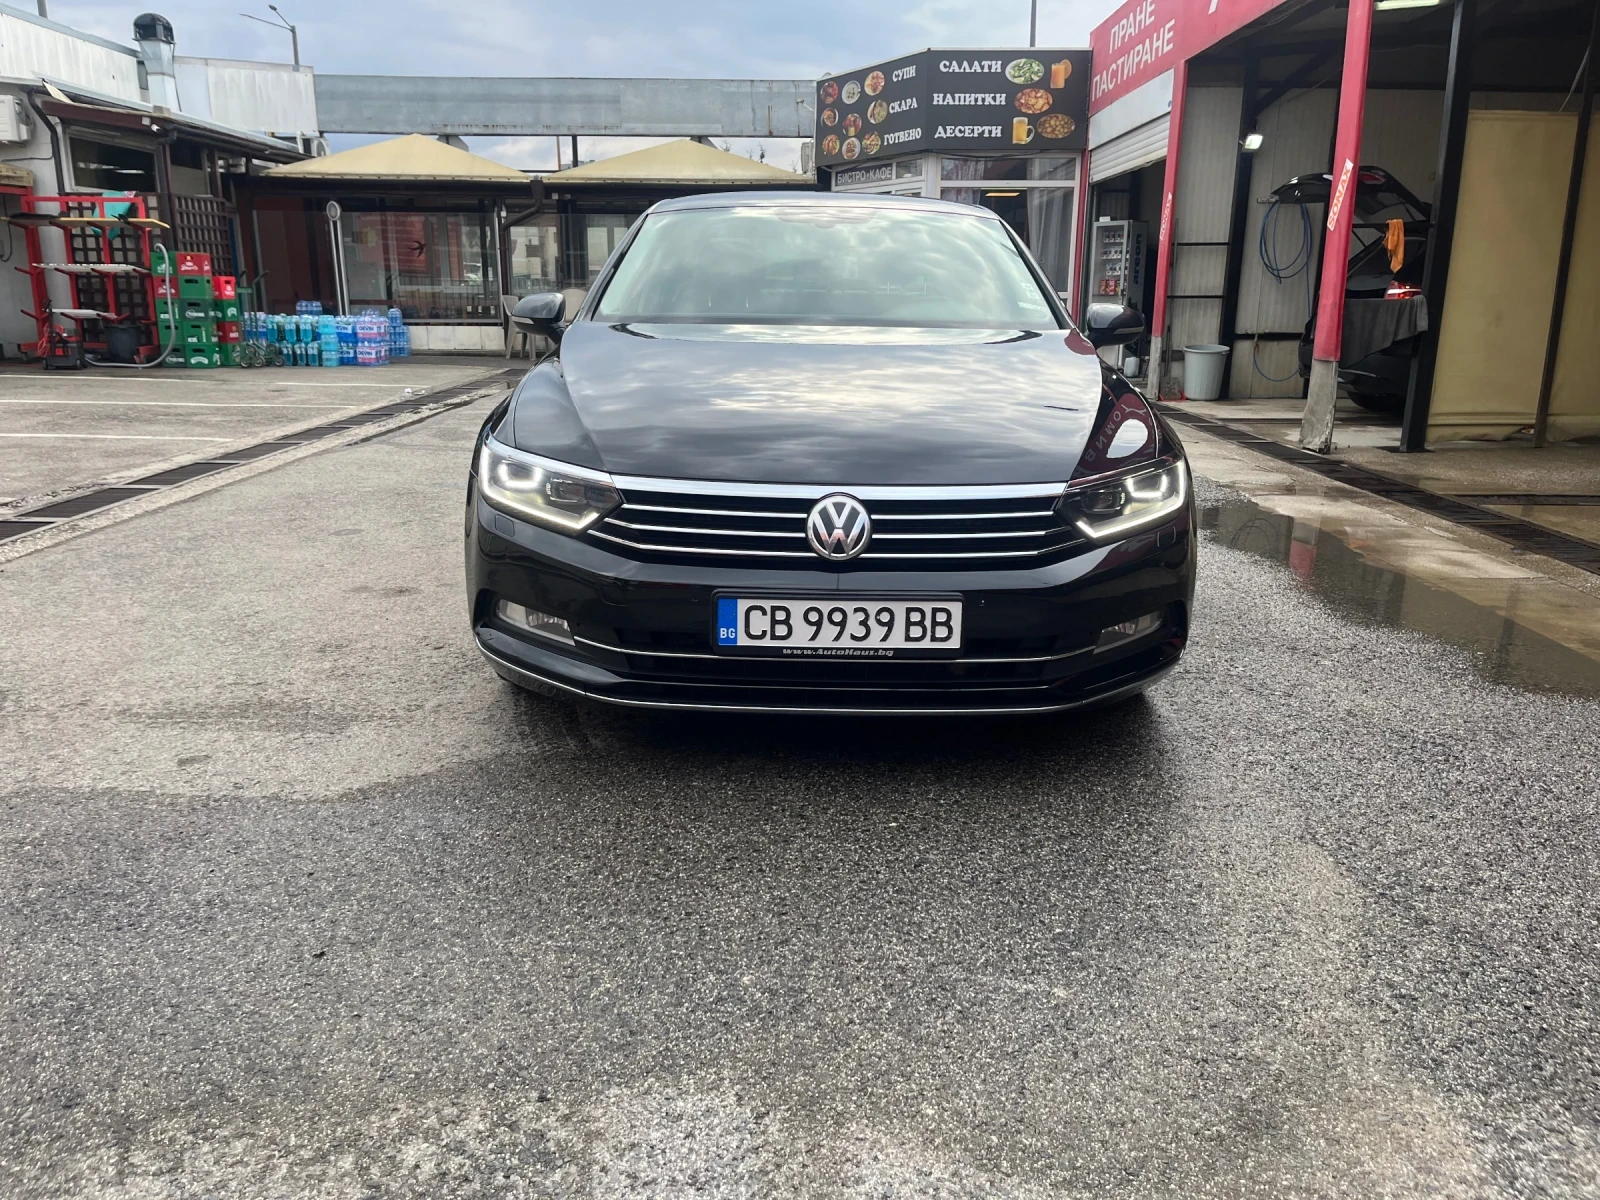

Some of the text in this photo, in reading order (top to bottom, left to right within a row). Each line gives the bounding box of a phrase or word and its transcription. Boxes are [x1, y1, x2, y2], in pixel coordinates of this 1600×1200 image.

[1109, 0, 1155, 54] ПРАНЕ
[939, 60, 1002, 73] САЛАТИ
[1092, 19, 1175, 102] ПАСТИРАНЕ
[892, 65, 917, 82] СУПИ
[888, 97, 918, 114] СКАРА
[932, 93, 1007, 105] НАПИТКИ
[883, 127, 922, 146] ГОТВЕНО
[934, 125, 1003, 139] ДЕСЕРТИ
[1328, 168, 1350, 229] SONAX
[744, 604, 953, 642] CB 9939 BB
[720, 627, 736, 639] BG
